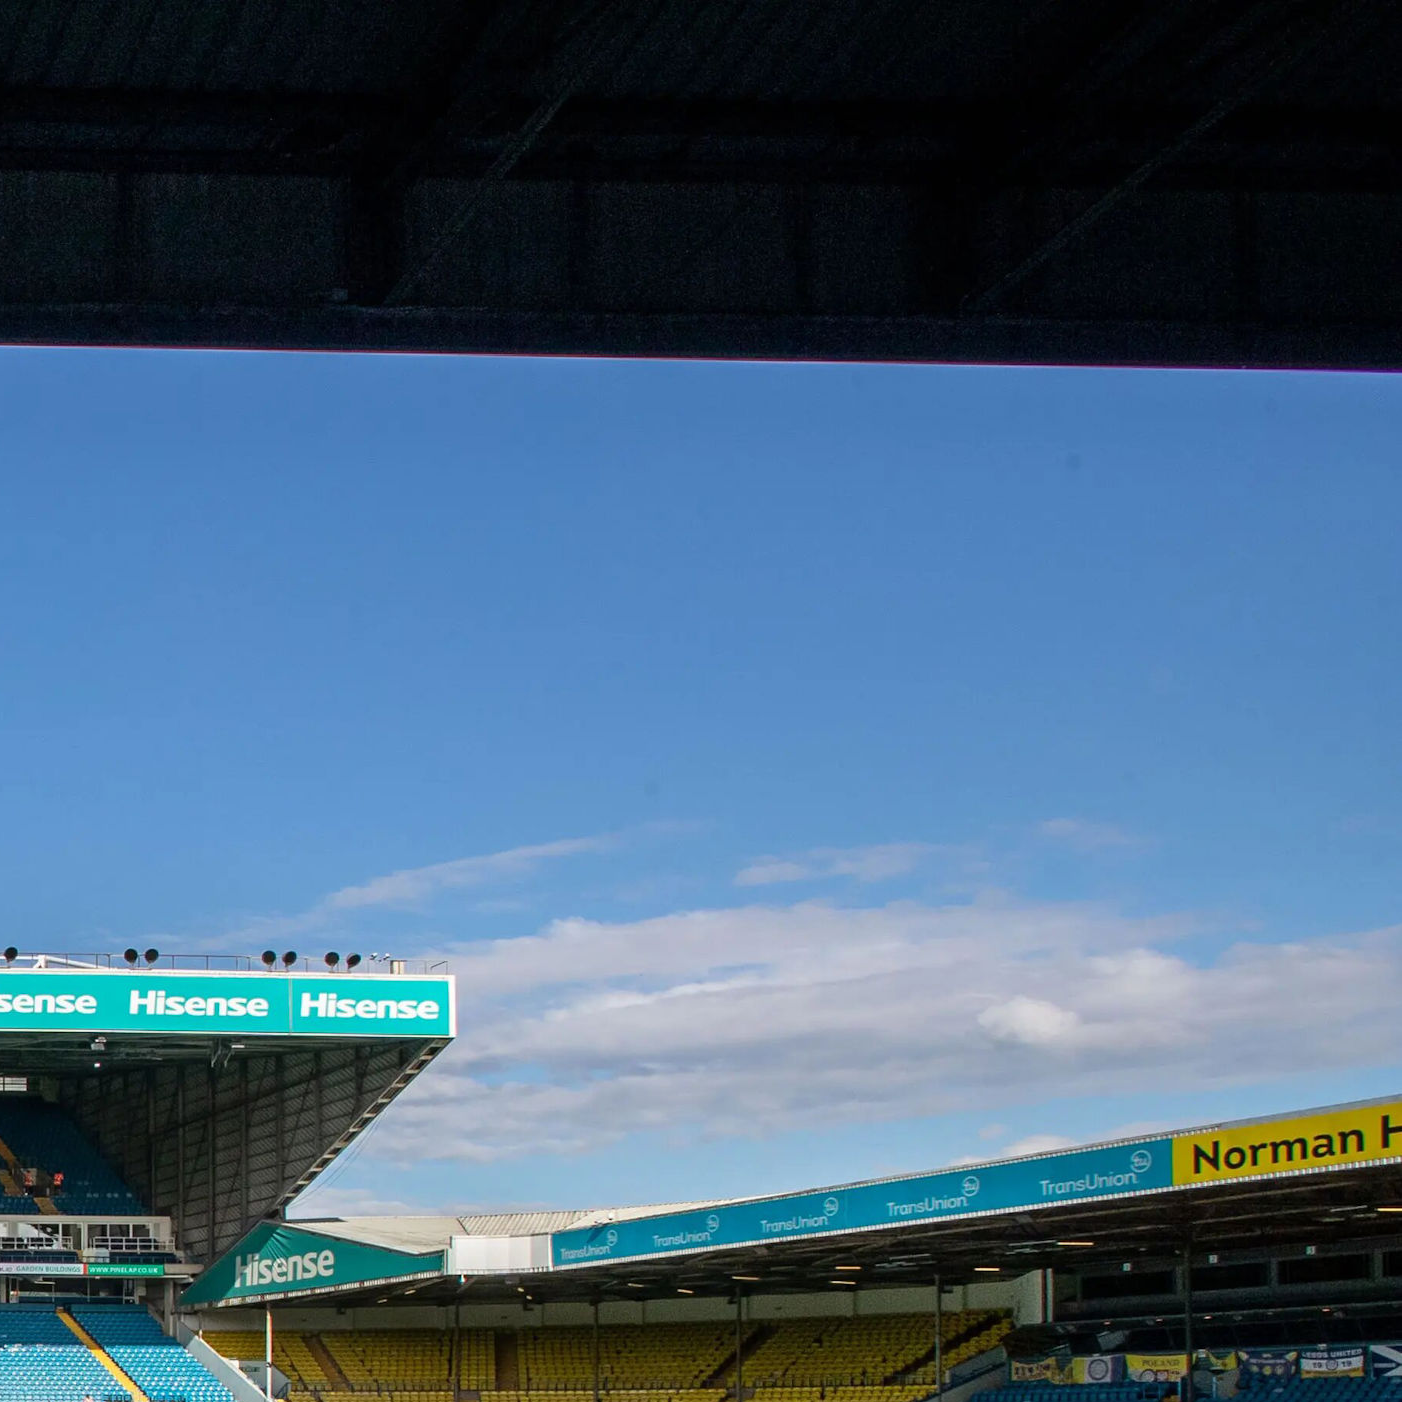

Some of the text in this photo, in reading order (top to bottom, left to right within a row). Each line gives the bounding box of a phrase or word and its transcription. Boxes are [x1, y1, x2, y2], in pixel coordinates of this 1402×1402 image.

[129, 989, 269, 1017] Hisense
[300, 992, 440, 1020] Hisense
[1193, 1128, 1365, 1175] Norman
[1039, 1170, 1138, 1196] TransUnion
[886, 1195, 969, 1217] TransUnion
[760, 1215, 830, 1234] TransUnion
[652, 1231, 712, 1247] TransUnion
[234, 1249, 335, 1288] Hisense
[1329, 1350, 1363, 1361] UNITED
